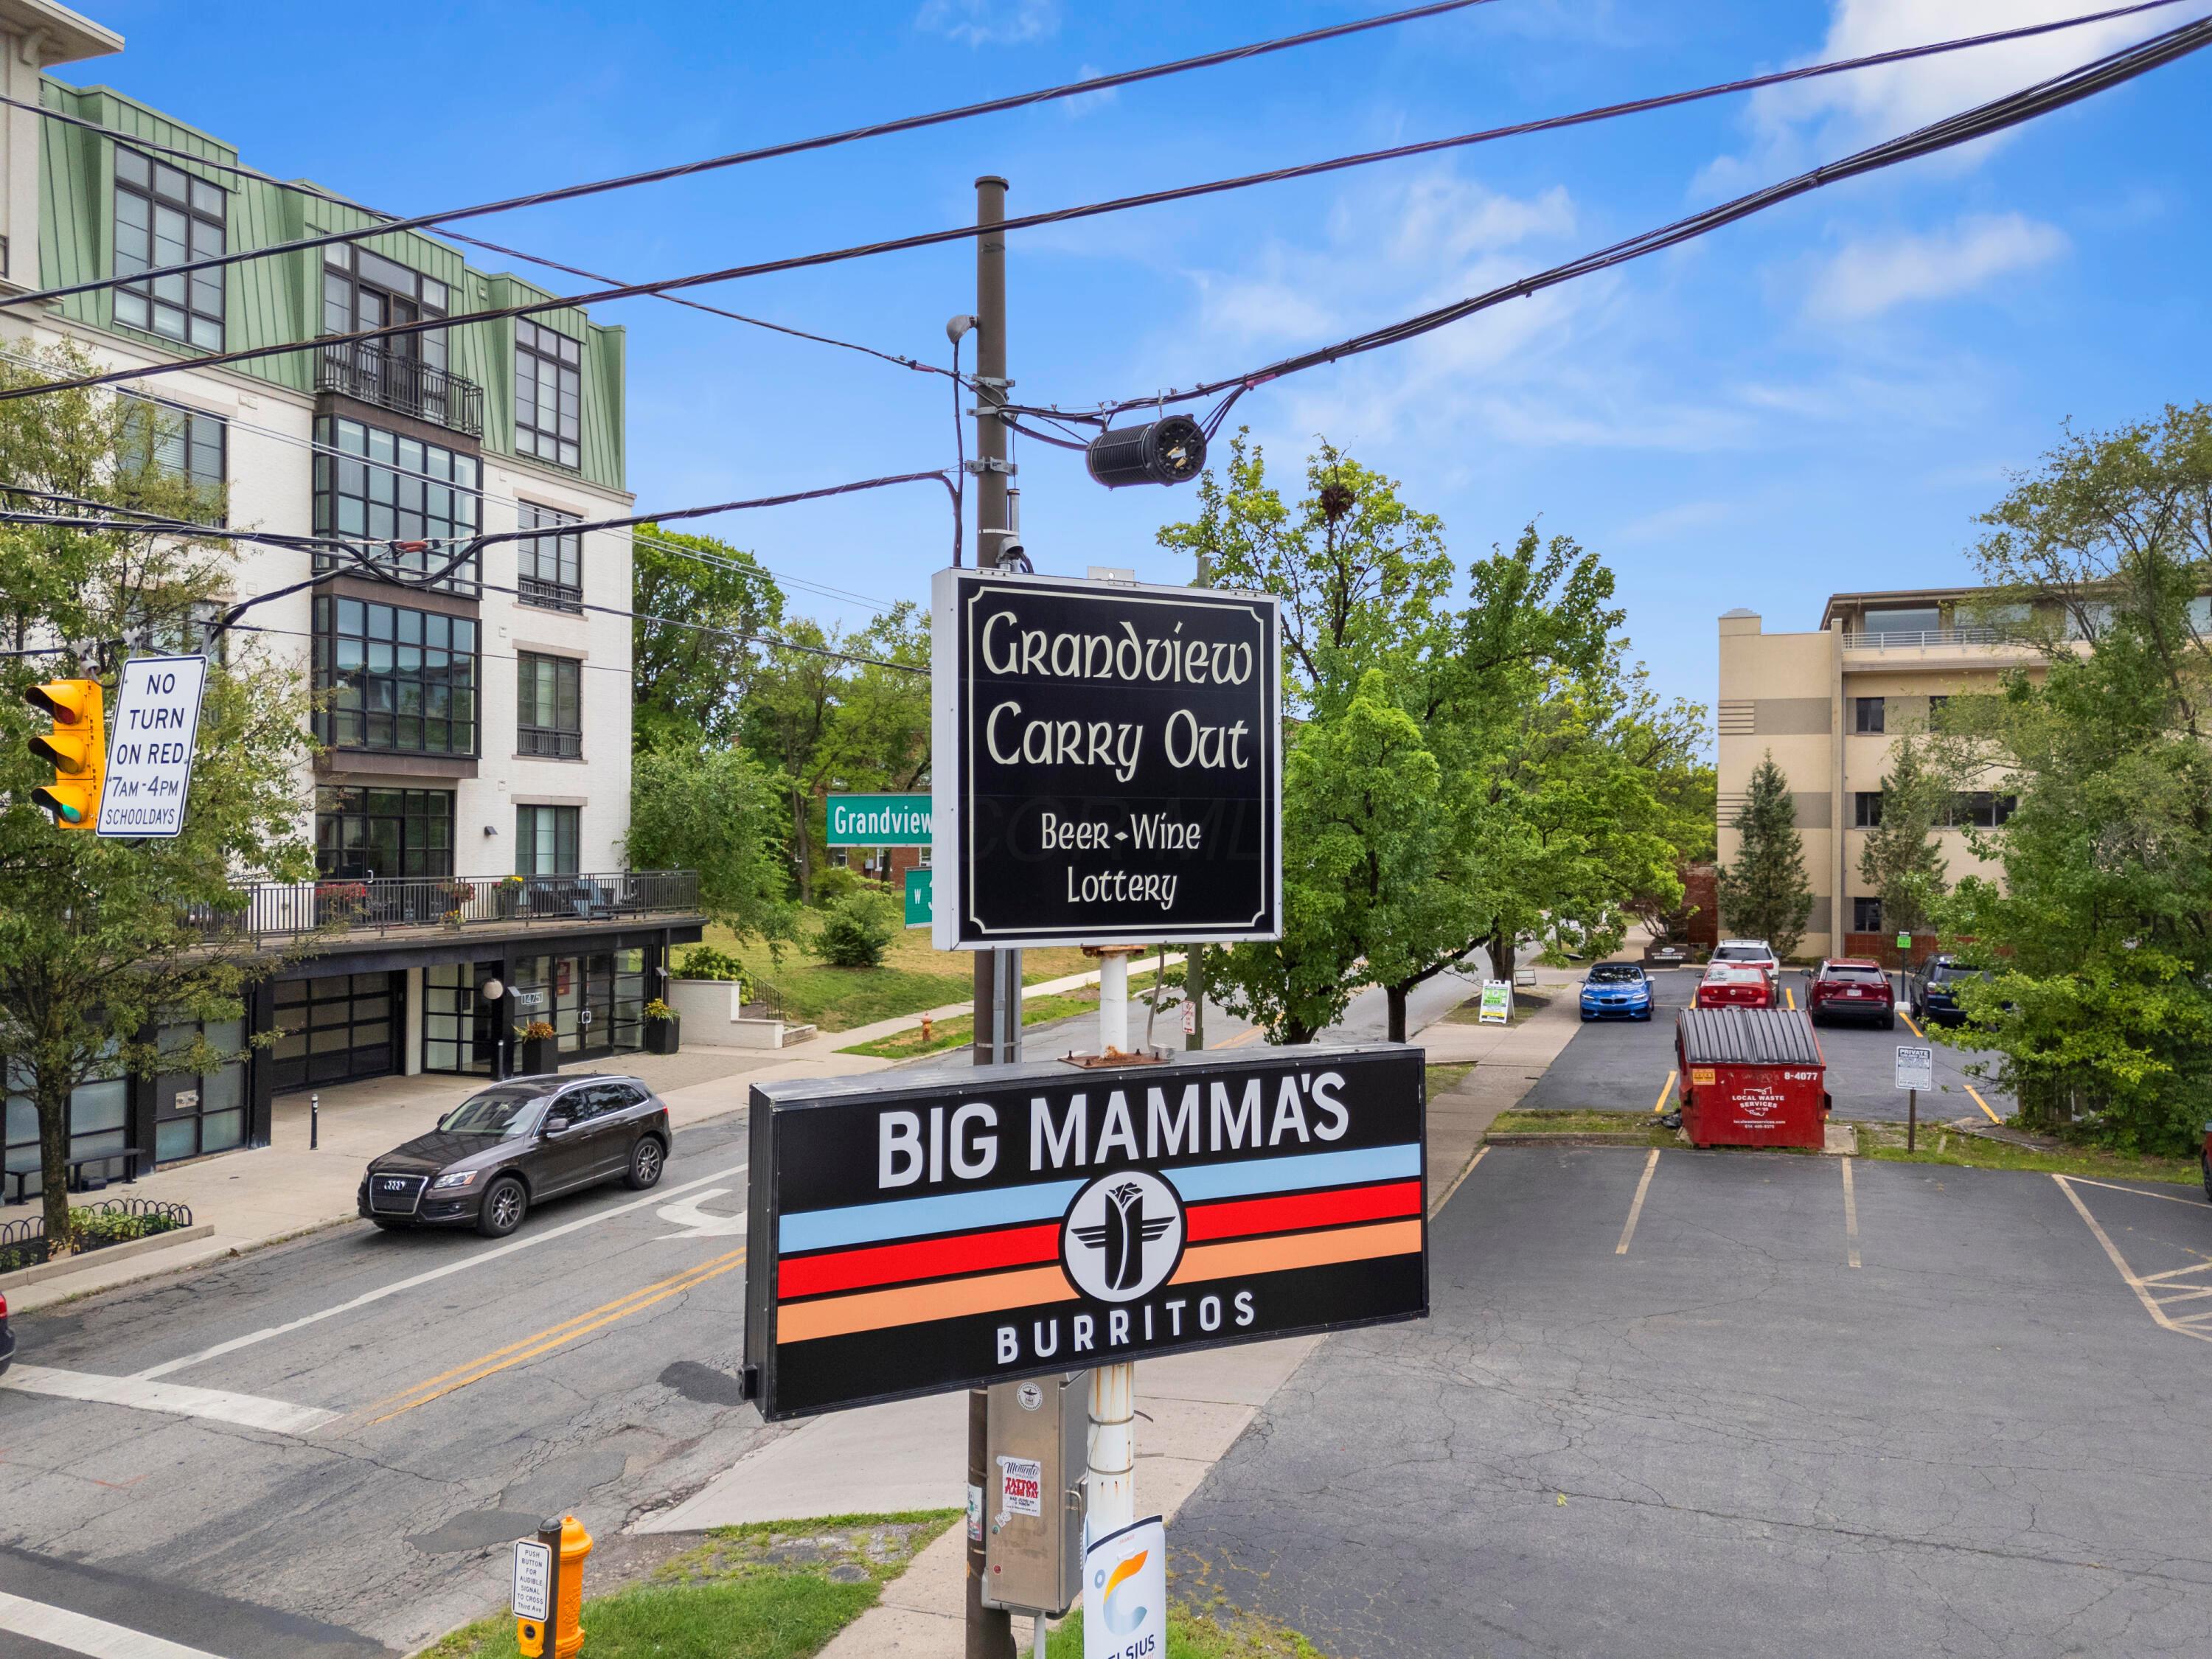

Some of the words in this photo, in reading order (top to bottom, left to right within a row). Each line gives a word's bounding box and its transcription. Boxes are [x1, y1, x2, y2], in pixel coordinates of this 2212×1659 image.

[982, 611, 1252, 685] Grandview
[147, 673, 175, 695] NO
[130, 707, 184, 729] TURN
[986, 701, 1144, 783] Carry
[1164, 709, 1248, 770] Out
[116, 743, 140, 765] ON
[147, 742, 184, 764] RED
[105, 808, 175, 826] SCHOOLDAYS
[835, 805, 932, 835] Grandview
[1041, 813, 1110, 849] Beer
[1130, 812, 1201, 849] Wine
[914, 888, 921, 904] W
[1067, 866, 1178, 911] Lottery
[878, 1102, 998, 1190] BIG
[1029, 1071, 1349, 1171] MAMMA'S
[997, 1291, 1256, 1364] BURRITOS
[1006, 1477, 1038, 1491] TATTOO
[1026, 1489, 1039, 1498] DAY
[522, 1558, 542, 1568] BUTTON
[525, 1550, 540, 1558] PUSH
[520, 1576, 543, 1586] AUDIBLE
[526, 1568, 537, 1576] FOR
[521, 1585, 540, 1595] SIGNAL
[526, 1596, 543, 1604] CROSS
[518, 1602, 530, 1610] Third
[1108, 1634, 1155, 1659] SIUS
